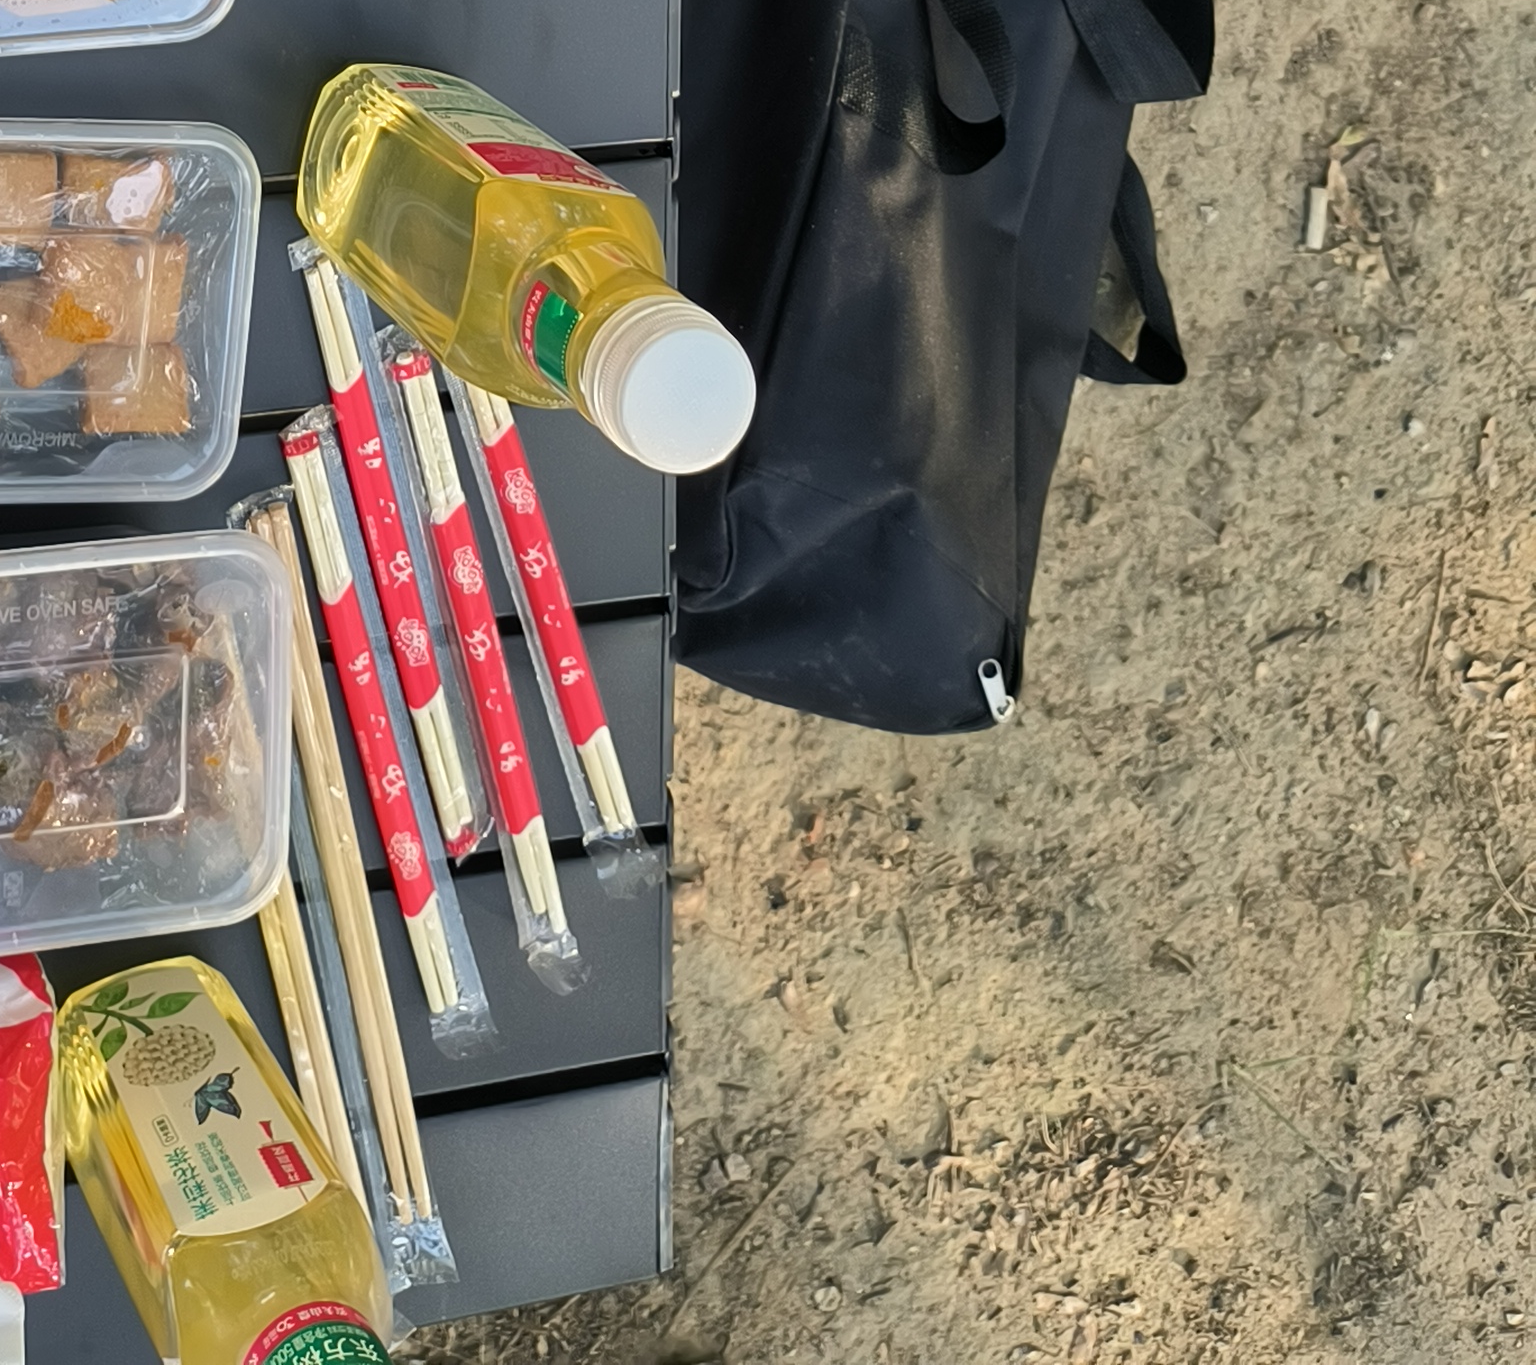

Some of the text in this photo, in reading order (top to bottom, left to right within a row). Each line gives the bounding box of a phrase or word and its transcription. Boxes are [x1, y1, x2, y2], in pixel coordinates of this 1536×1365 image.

[26, 601, 76, 622] OVEN
[164, 1145, 220, 1221] 茉莉花茶
